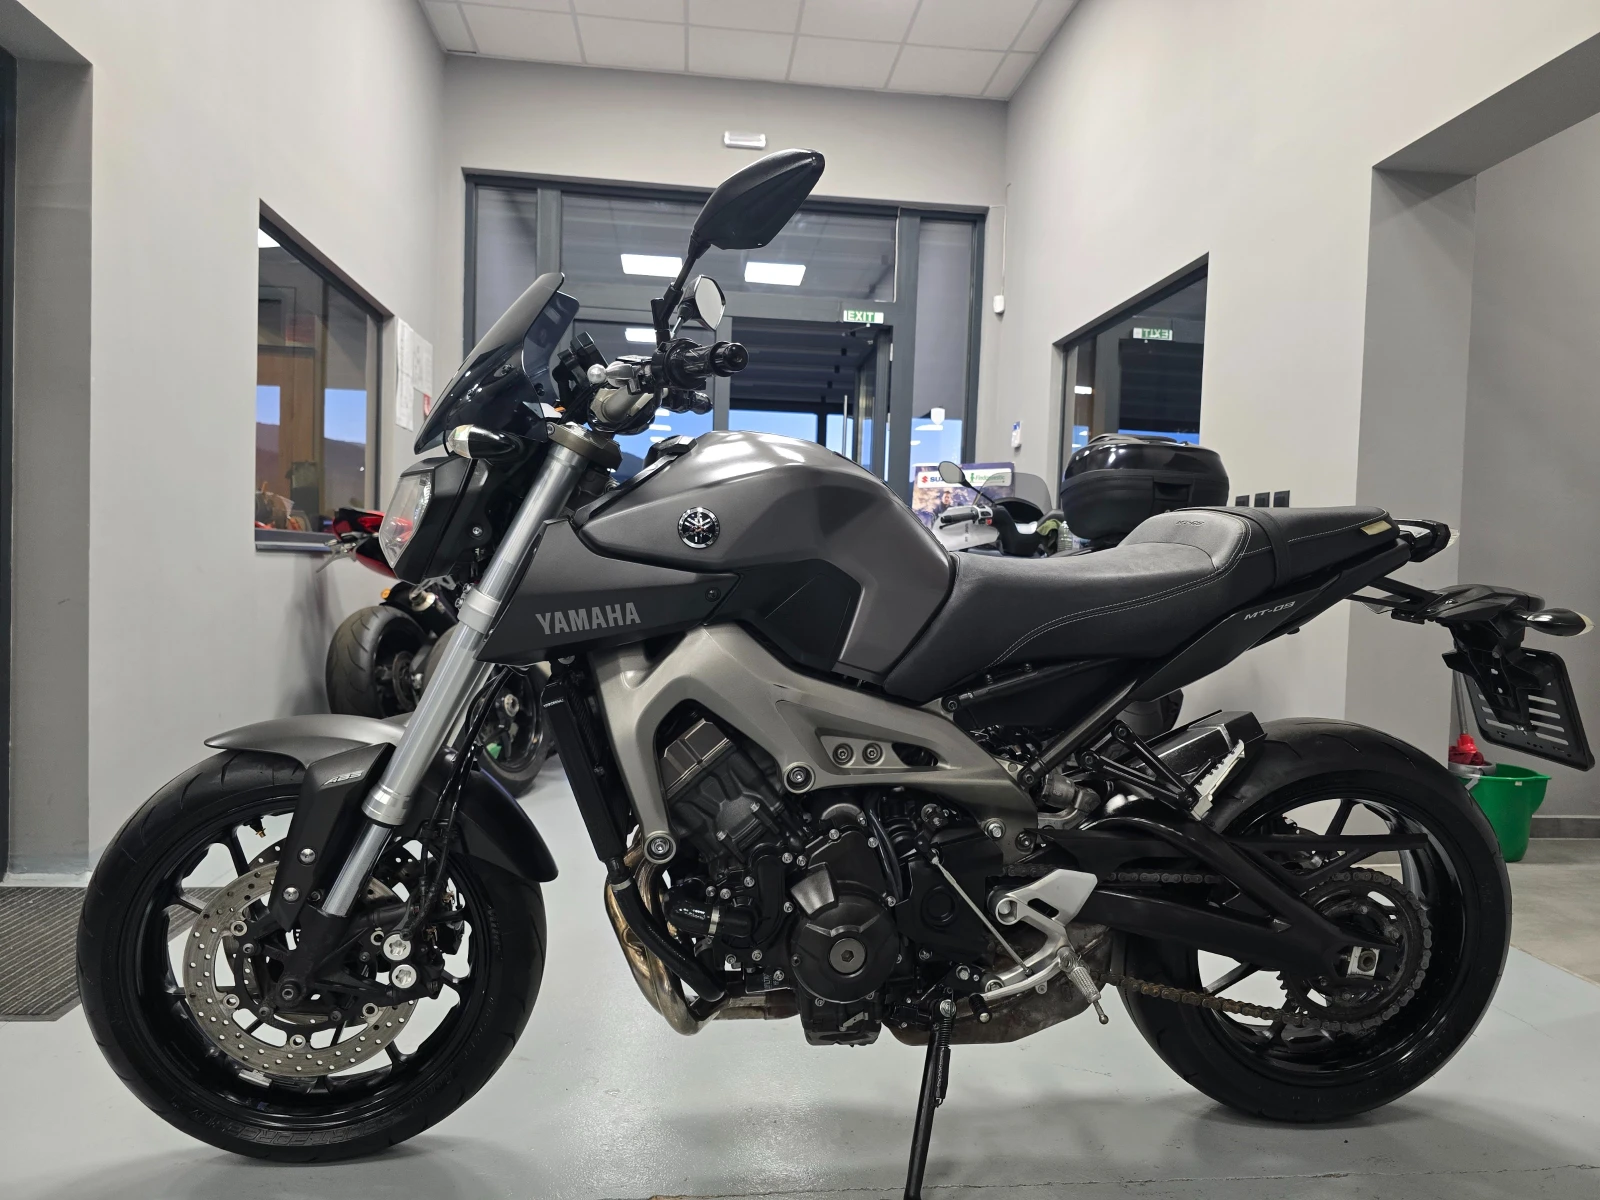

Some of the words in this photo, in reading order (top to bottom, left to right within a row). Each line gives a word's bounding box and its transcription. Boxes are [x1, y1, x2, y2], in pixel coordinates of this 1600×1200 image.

[847, 310, 875, 322] EXIT
[535, 602, 642, 635] YAMAHA
[1243, 600, 1296, 620] MT-09
